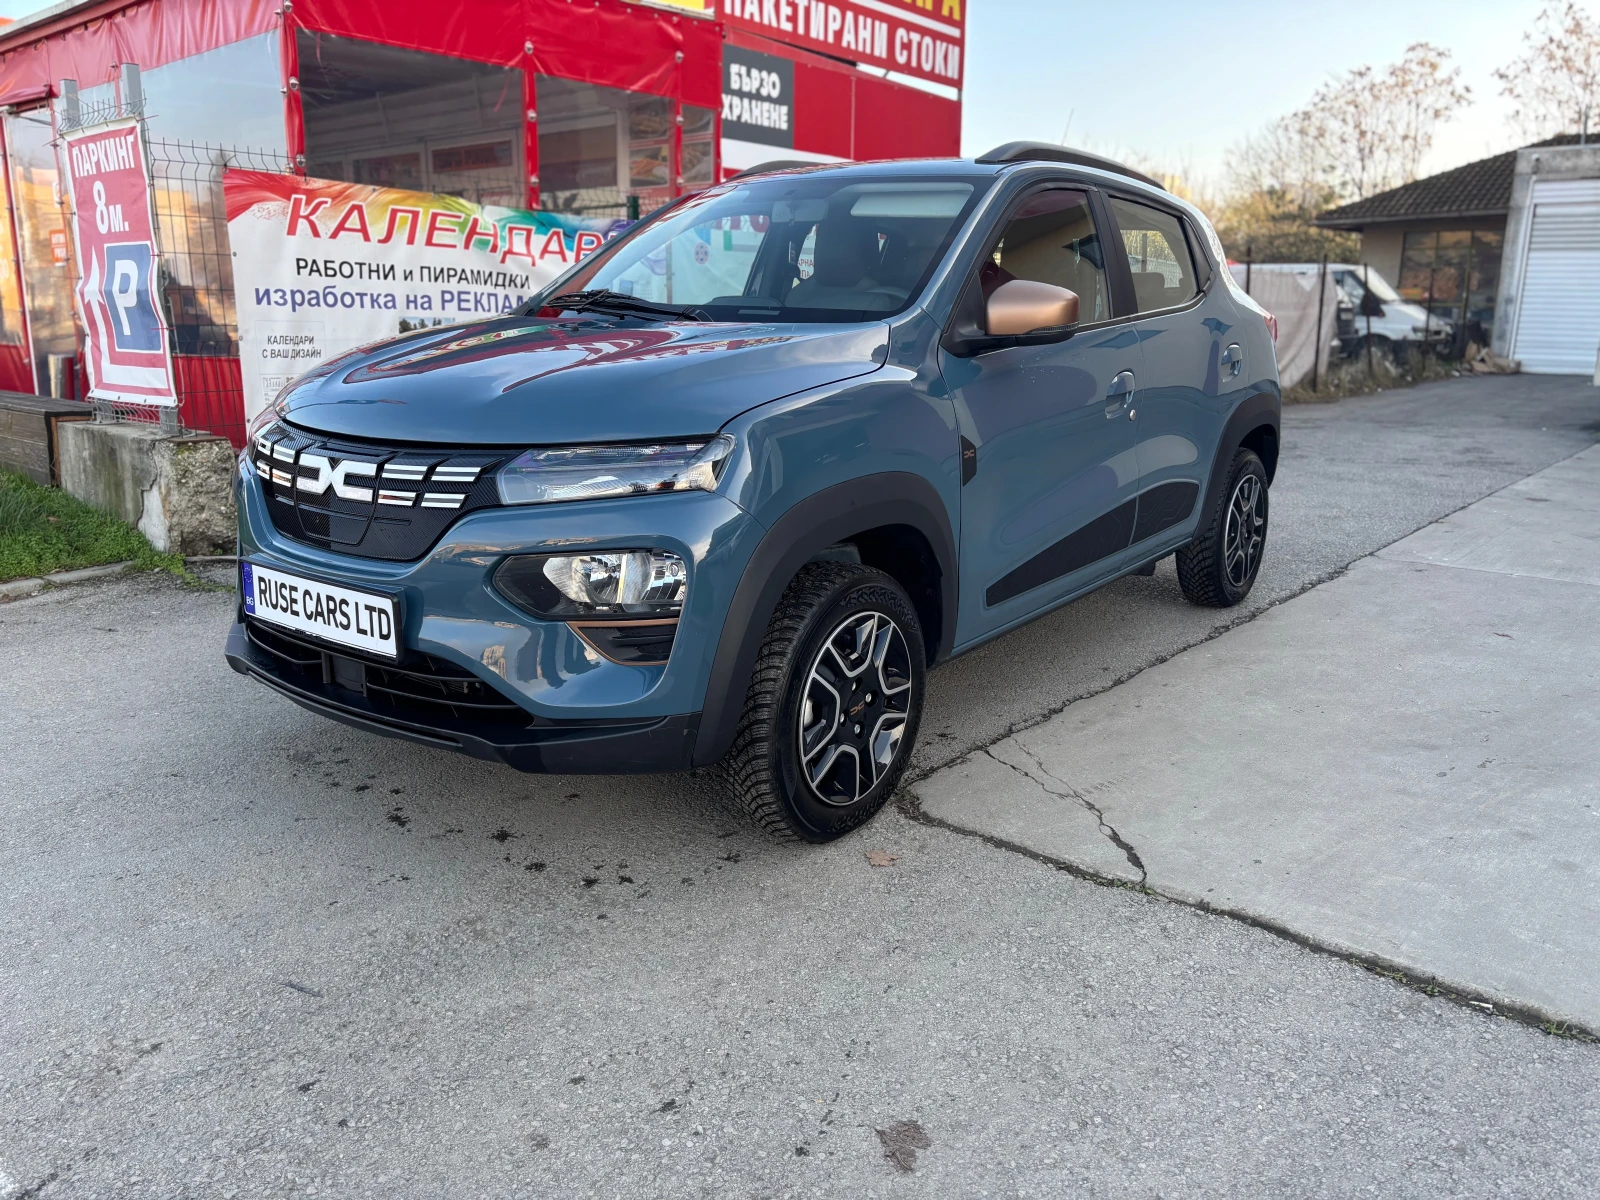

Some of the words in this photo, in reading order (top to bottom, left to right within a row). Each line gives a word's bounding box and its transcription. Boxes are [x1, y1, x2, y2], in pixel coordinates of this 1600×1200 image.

[894, 27, 960, 80] СТОКИ
[729, 63, 781, 99] БЪРЗО
[721, 93, 789, 130] ХРАНЕНЕ
[72, 135, 135, 178] ПАРКИНГ
[286, 194, 616, 267] КАЛЕНДАР
[296, 258, 396, 281] РАБОТНИ
[420, 266, 531, 290] ПИРАМИДКИ
[255, 285, 397, 312] изработка
[405, 294, 433, 311] на
[262, 349, 268, 359] С
[270, 349, 289, 359] ВАШ
[290, 346, 322, 360] ДИЗАЙН
[267, 335, 315, 346] КАЛЕНДАРИ
[246, 595, 254, 606] BG
[258, 576, 300, 617] RUSE
[303, 589, 351, 631] CARS
[354, 601, 392, 641] LTD
